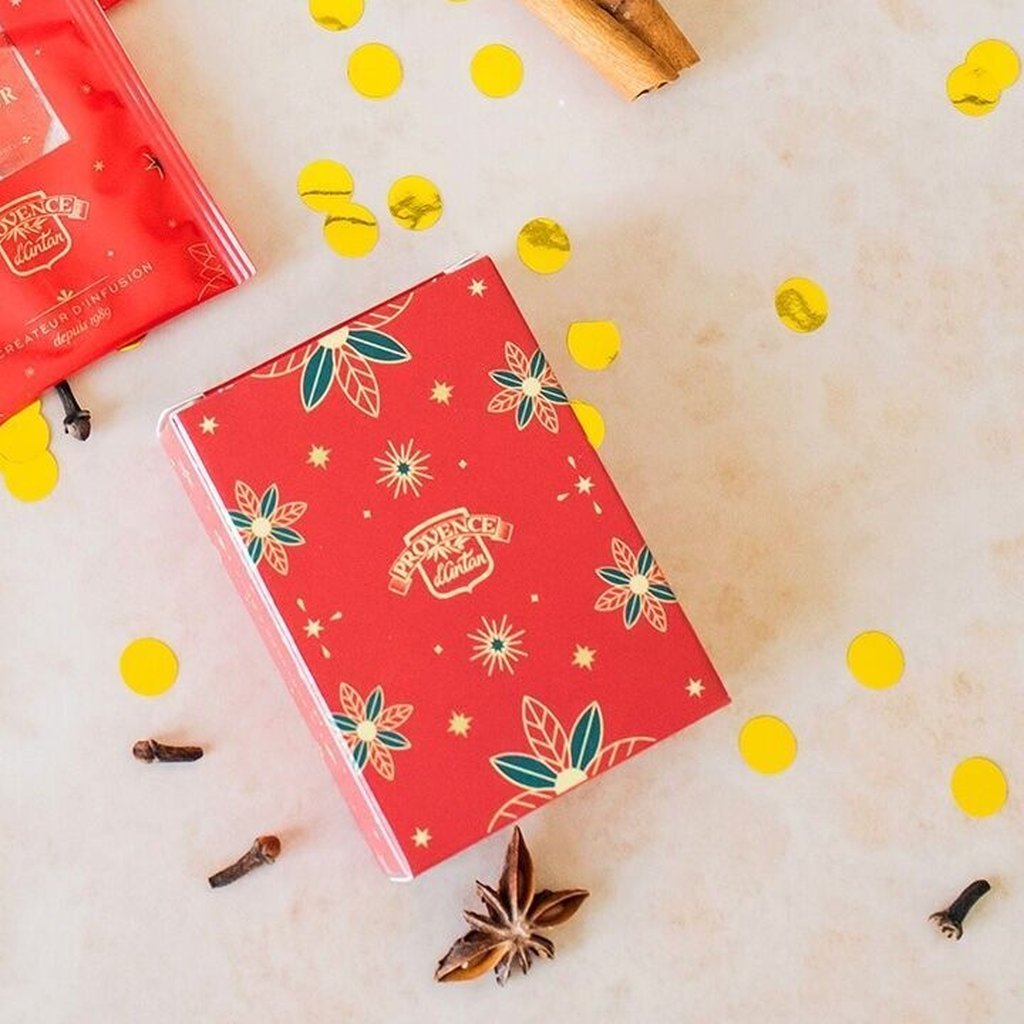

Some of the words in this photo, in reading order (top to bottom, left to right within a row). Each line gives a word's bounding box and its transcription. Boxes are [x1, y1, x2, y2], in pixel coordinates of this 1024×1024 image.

[52, 322, 87, 349] depuis
[88, 306, 112, 327] 1989
[392, 516, 498, 582] PROVENCE
